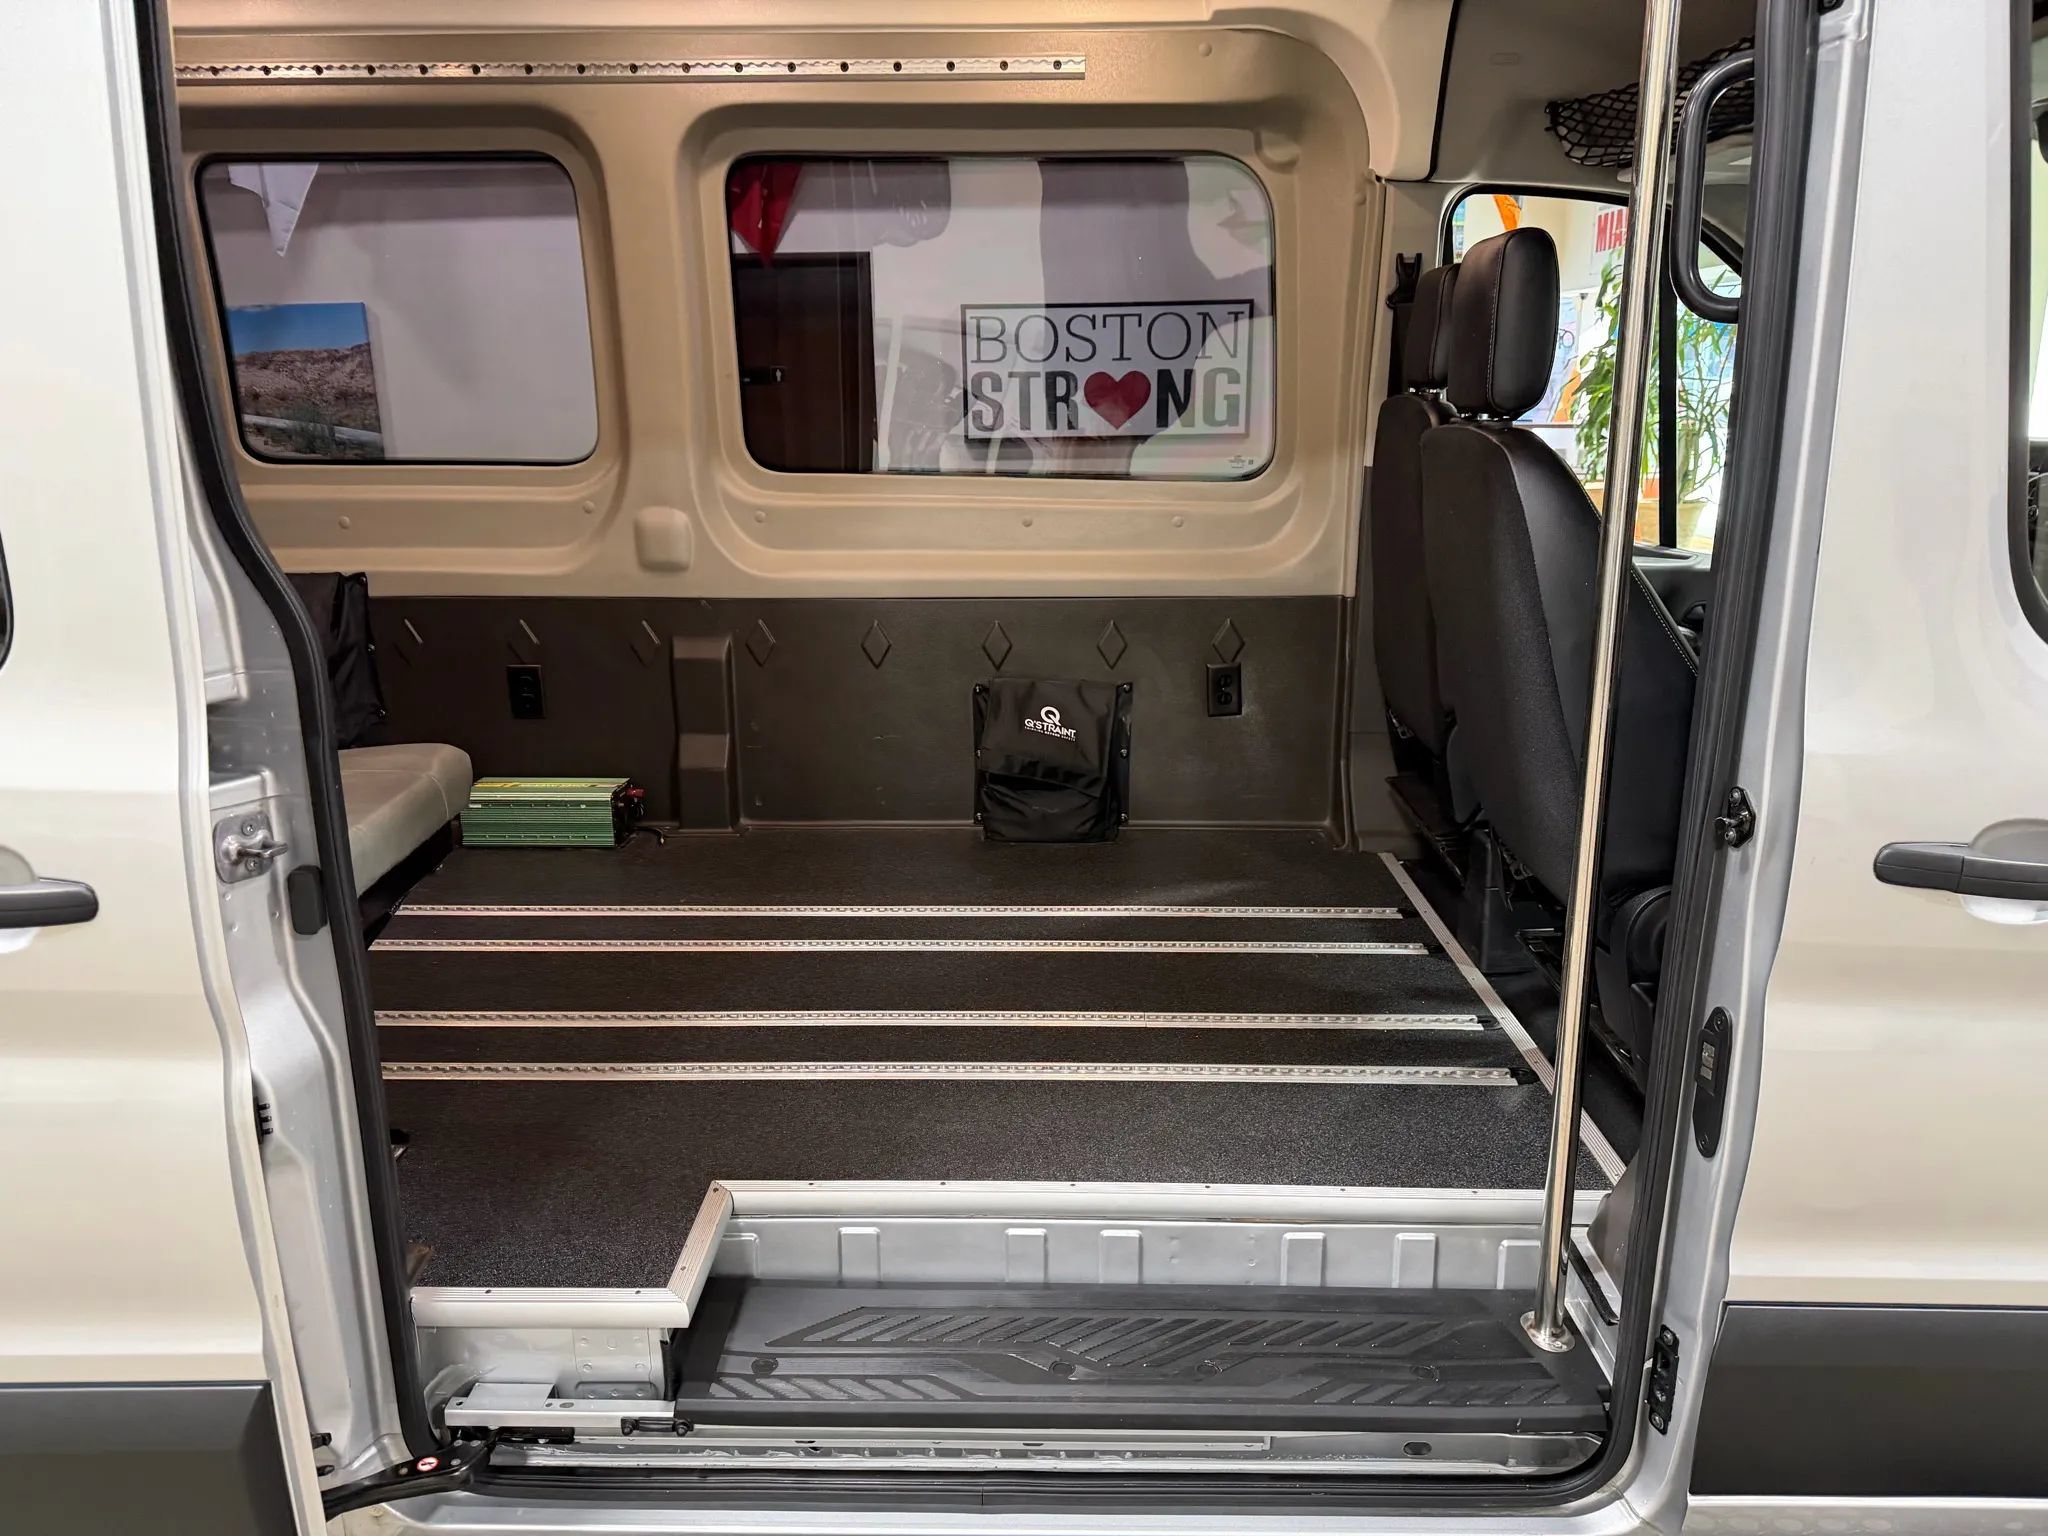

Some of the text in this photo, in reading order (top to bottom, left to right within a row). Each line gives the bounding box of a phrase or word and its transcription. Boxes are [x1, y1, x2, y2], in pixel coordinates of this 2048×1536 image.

[1596, 208, 1629, 253] MIA
[969, 311, 1245, 364] BOSTON
[970, 366, 1241, 432] STRNG
[1024, 718, 1077, 739] Q'STRAINT
[1040, 706, 1062, 727] Q
